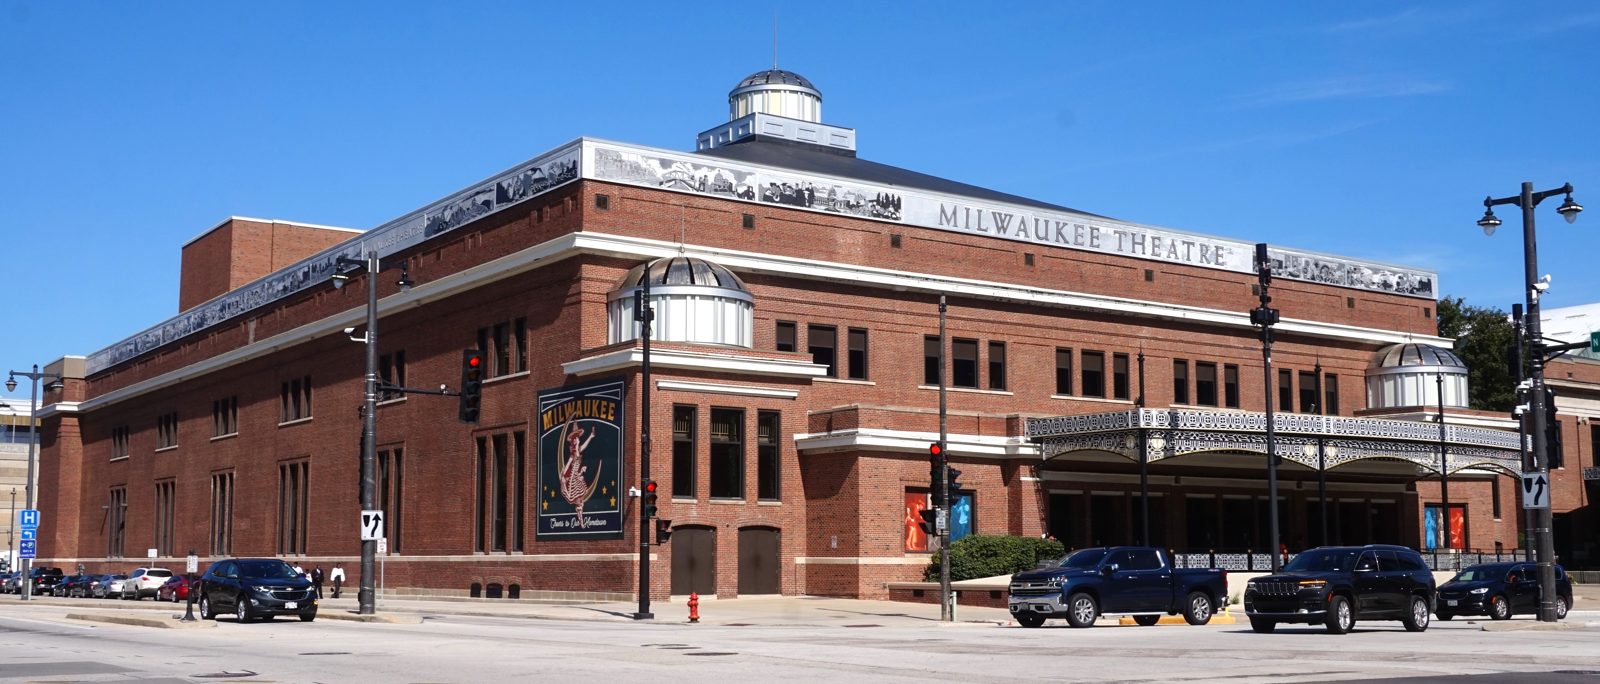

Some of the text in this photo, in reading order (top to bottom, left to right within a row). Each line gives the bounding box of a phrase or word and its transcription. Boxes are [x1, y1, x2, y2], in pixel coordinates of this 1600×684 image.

[937, 203, 1227, 266] MILWAUKEE THEATRE
[543, 399, 616, 431] MILWAUKEE
[24, 511, 35, 524] H
